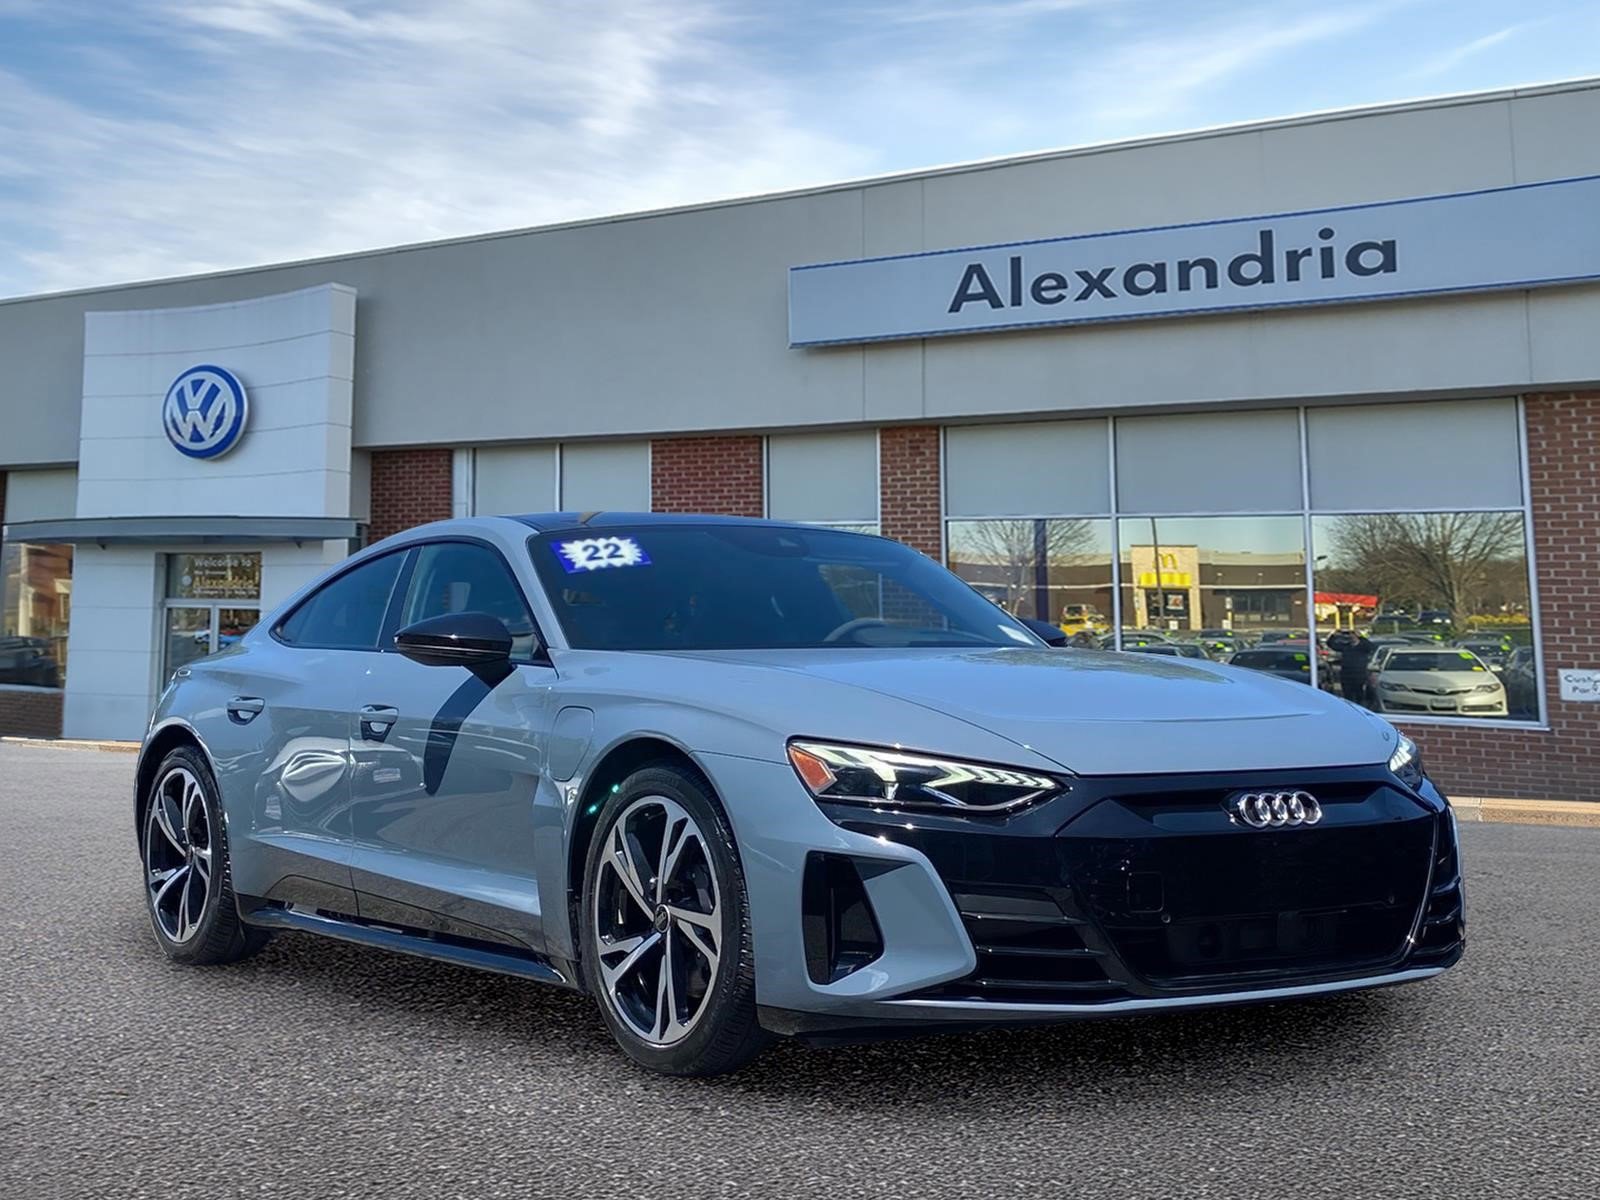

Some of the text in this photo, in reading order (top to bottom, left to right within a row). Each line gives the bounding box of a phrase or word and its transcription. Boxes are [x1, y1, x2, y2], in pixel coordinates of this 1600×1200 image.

[948, 228, 1397, 314] Alexandria
[582, 543, 625, 561] 22
[194, 558, 252, 567] Welcome to
